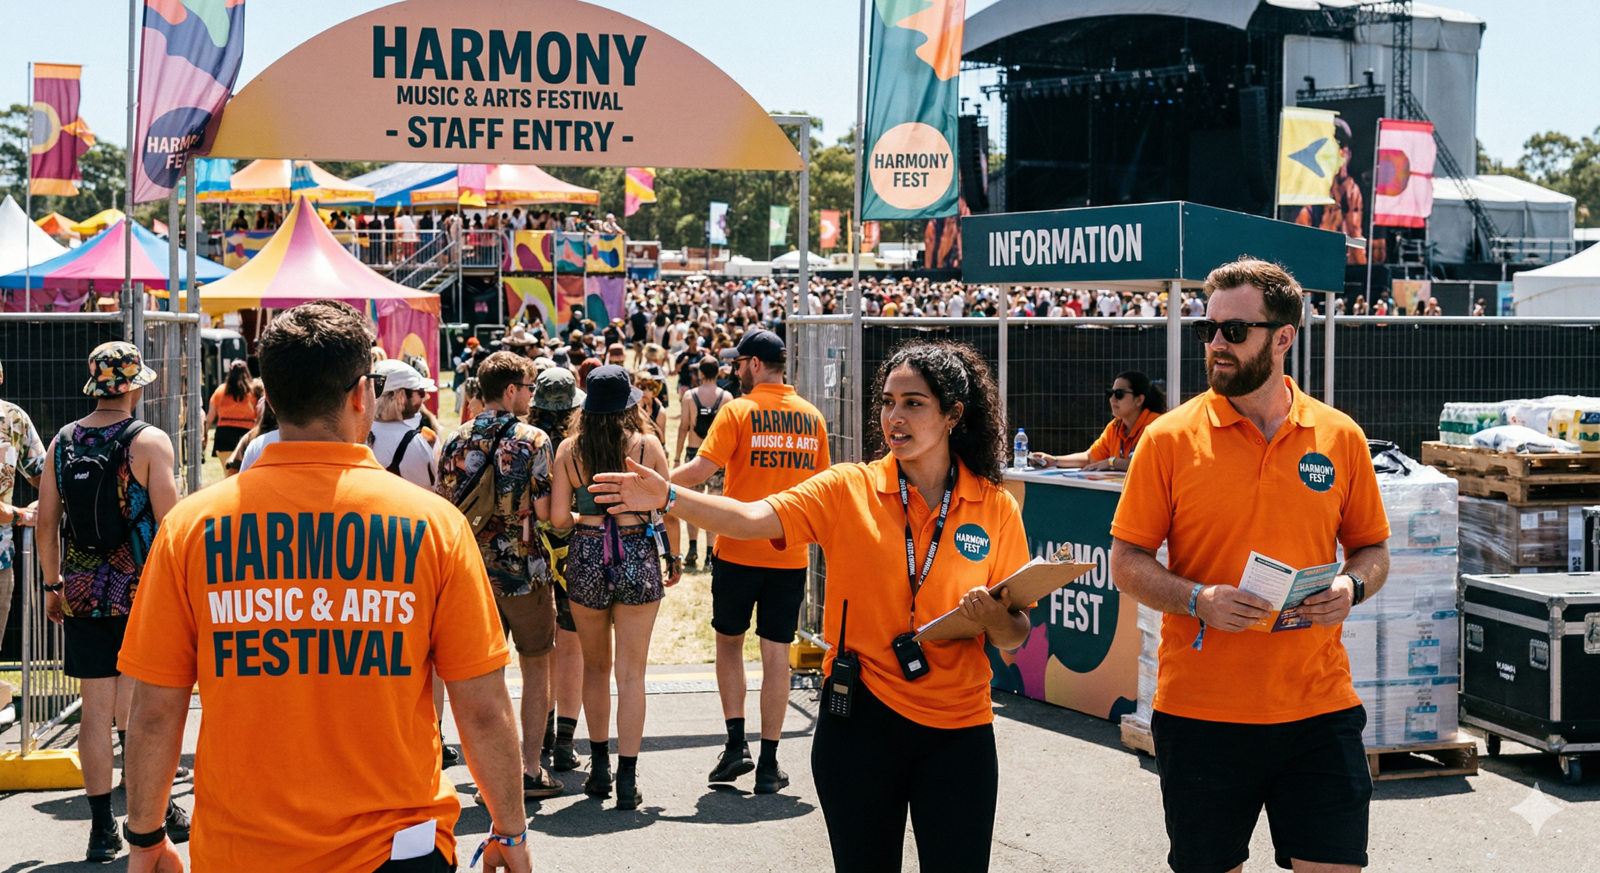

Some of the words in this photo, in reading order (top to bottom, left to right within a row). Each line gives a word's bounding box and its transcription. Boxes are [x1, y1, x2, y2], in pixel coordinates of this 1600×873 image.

[373, 25, 647, 86] HARMONY
[397, 85, 459, 106] MUSIC
[463, 87, 478, 107] &
[482, 88, 532, 108] ARTS
[537, 89, 623, 111] FESTIVAL
[407, 116, 504, 149] STAFF
[513, 119, 614, 152] ENTRY
[874, 153, 949, 169] HARMONY
[893, 171, 929, 187] FEST
[989, 222, 1142, 267] INFORMATION
[750, 409, 818, 436] HARMONY
[751, 435, 784, 448] MUSIC
[785, 435, 794, 449] &
[796, 436, 818, 451] ARTS
[750, 450, 815, 470] FESTIVAL
[1299, 463, 1334, 476] HARMONY
[1309, 473, 1326, 483] FEST
[205, 511, 428, 585] HARMONY
[956, 532, 989, 547] HARMONY
[964, 542, 980, 554] FEST
[207, 587, 304, 624] MUSIC
[310, 587, 334, 622] &
[340, 588, 416, 624] ARTS
[1050, 587, 1103, 635] FEST
[213, 628, 412, 678] FESTIVAL
